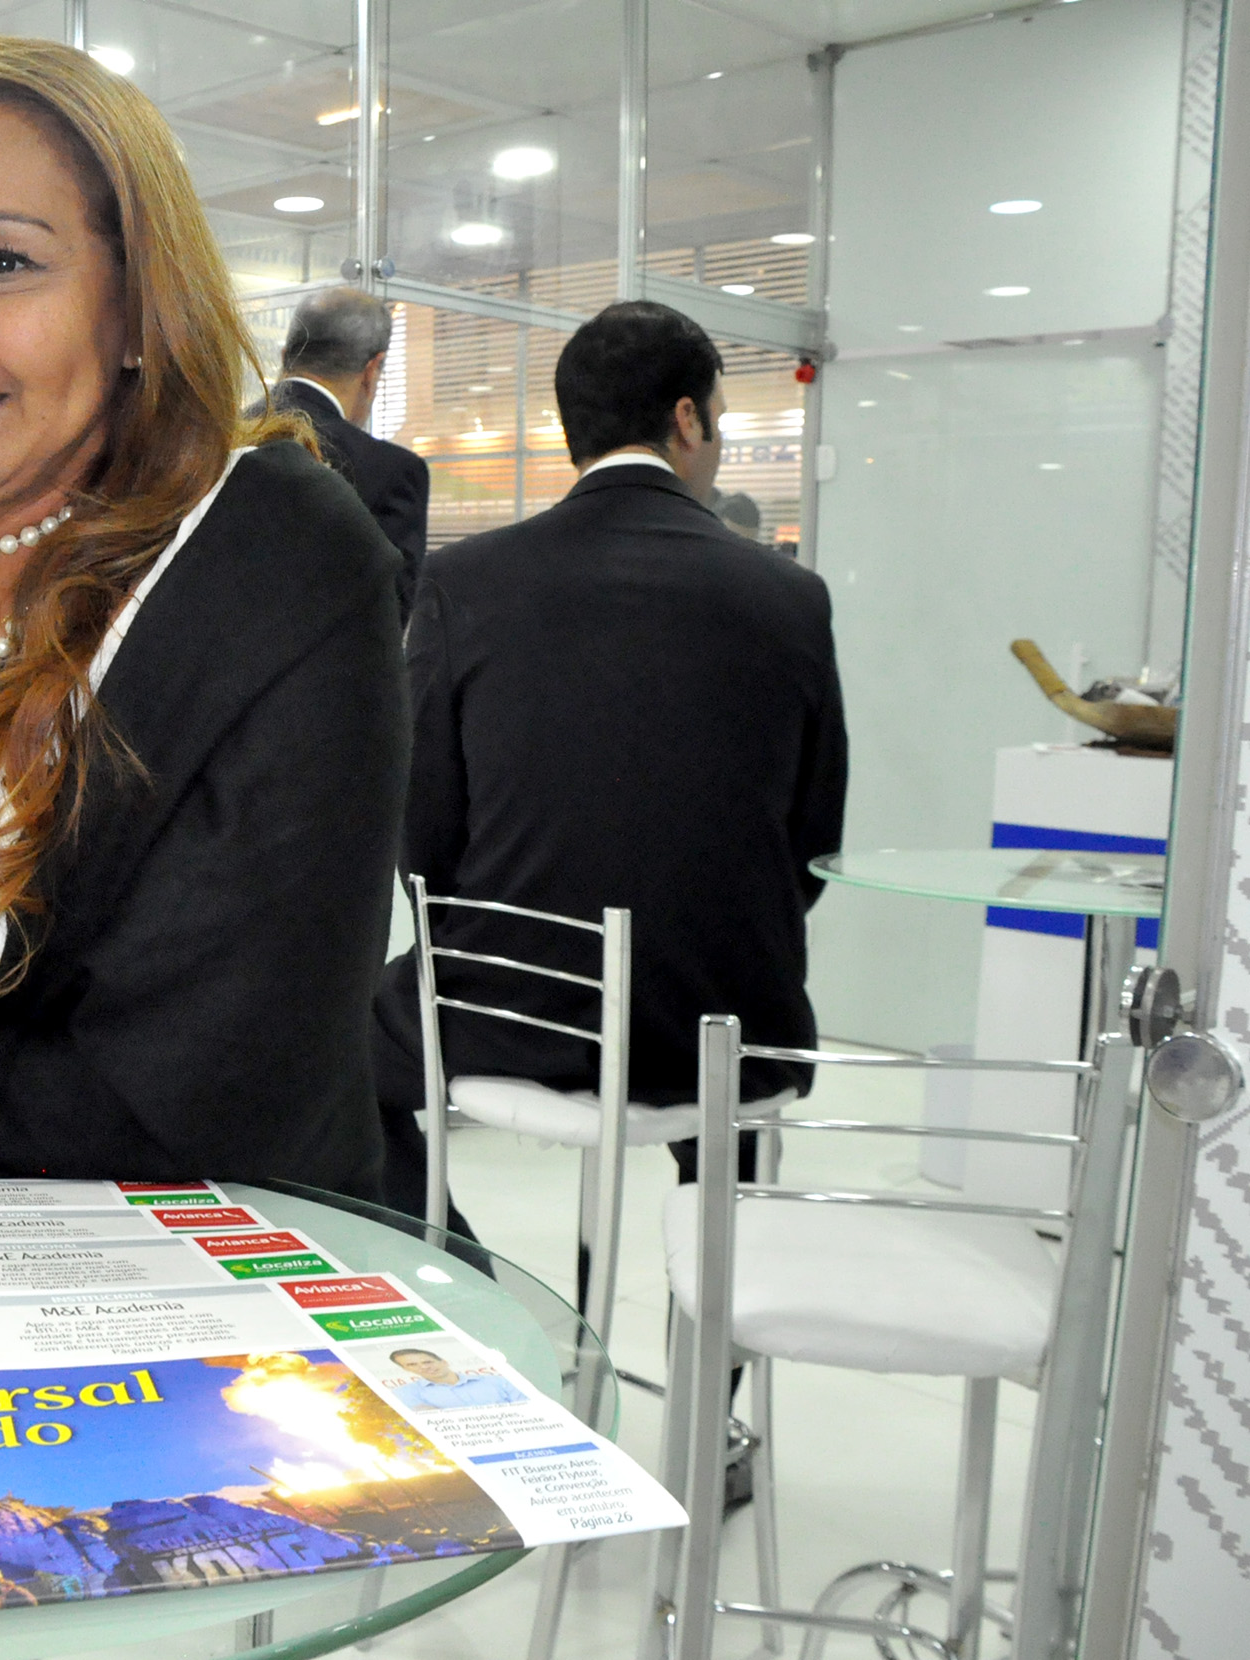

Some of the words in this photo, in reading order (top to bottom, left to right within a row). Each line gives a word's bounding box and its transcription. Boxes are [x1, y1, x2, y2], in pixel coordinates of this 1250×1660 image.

[162, 1211, 223, 1221] Avianca
[206, 1235, 270, 1248] Avianca
[22, 1251, 104, 1260] Academia
[252, 1257, 324, 1271] Localiza
[293, 1282, 363, 1295] Avianca
[40, 1304, 91, 1317] M&E
[95, 1300, 186, 1315] Academia
[349, 1314, 425, 1330] Localiza
[426, 1417, 453, 1427] Após
[434, 1424, 461, 1433] GRU
[464, 1420, 503, 1432] Airport
[506, 1416, 546, 1426] investe
[465, 1428, 511, 1439] serviços
[513, 1422, 565, 1435] premium
[451, 1436, 493, 1448] Página
[501, 1467, 521, 1477] FIT
[523, 1463, 567, 1475] Buenos
[569, 1457, 602, 1469] Aires,
[520, 1472, 557, 1485] Feirão
[558, 1468, 603, 1483] Flytour,
[535, 1486, 543, 1495] e
[544, 1477, 608, 1495] Convenção
[530, 1493, 568, 1508] Aviesp
[571, 1486, 634, 1502] acontecem
[556, 1506, 577, 1517] em
[579, 1500, 628, 1514] outubro.
[569, 1513, 614, 1531] Página
[616, 1511, 634, 1524] 26
[151, 1533, 326, 1589] KONG
